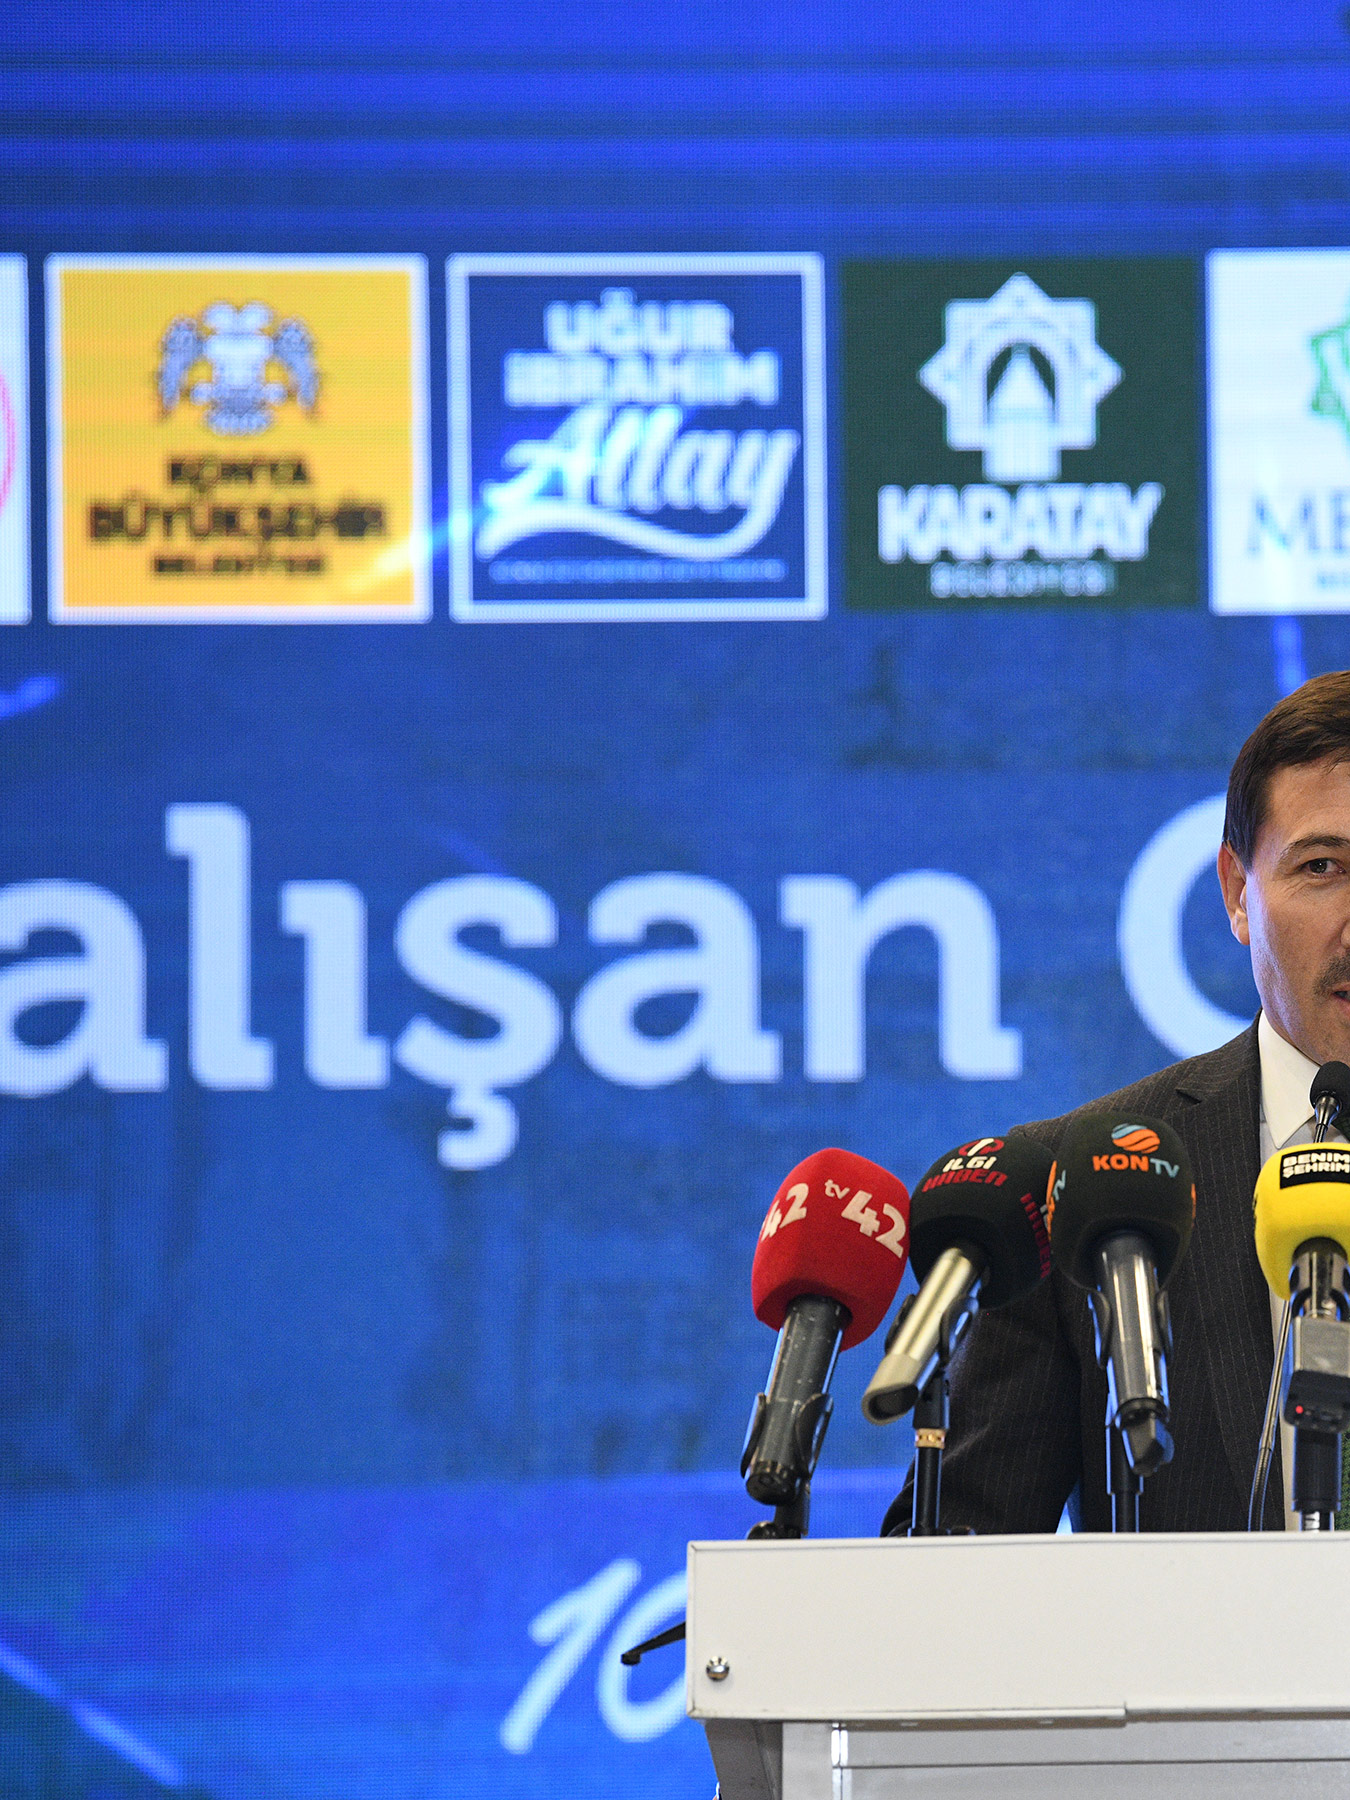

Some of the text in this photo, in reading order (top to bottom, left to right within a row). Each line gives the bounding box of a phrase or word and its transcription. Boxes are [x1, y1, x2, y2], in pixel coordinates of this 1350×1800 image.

[878, 482, 1165, 564] KARATAY
[824, 1179, 906, 1259] tv 42
